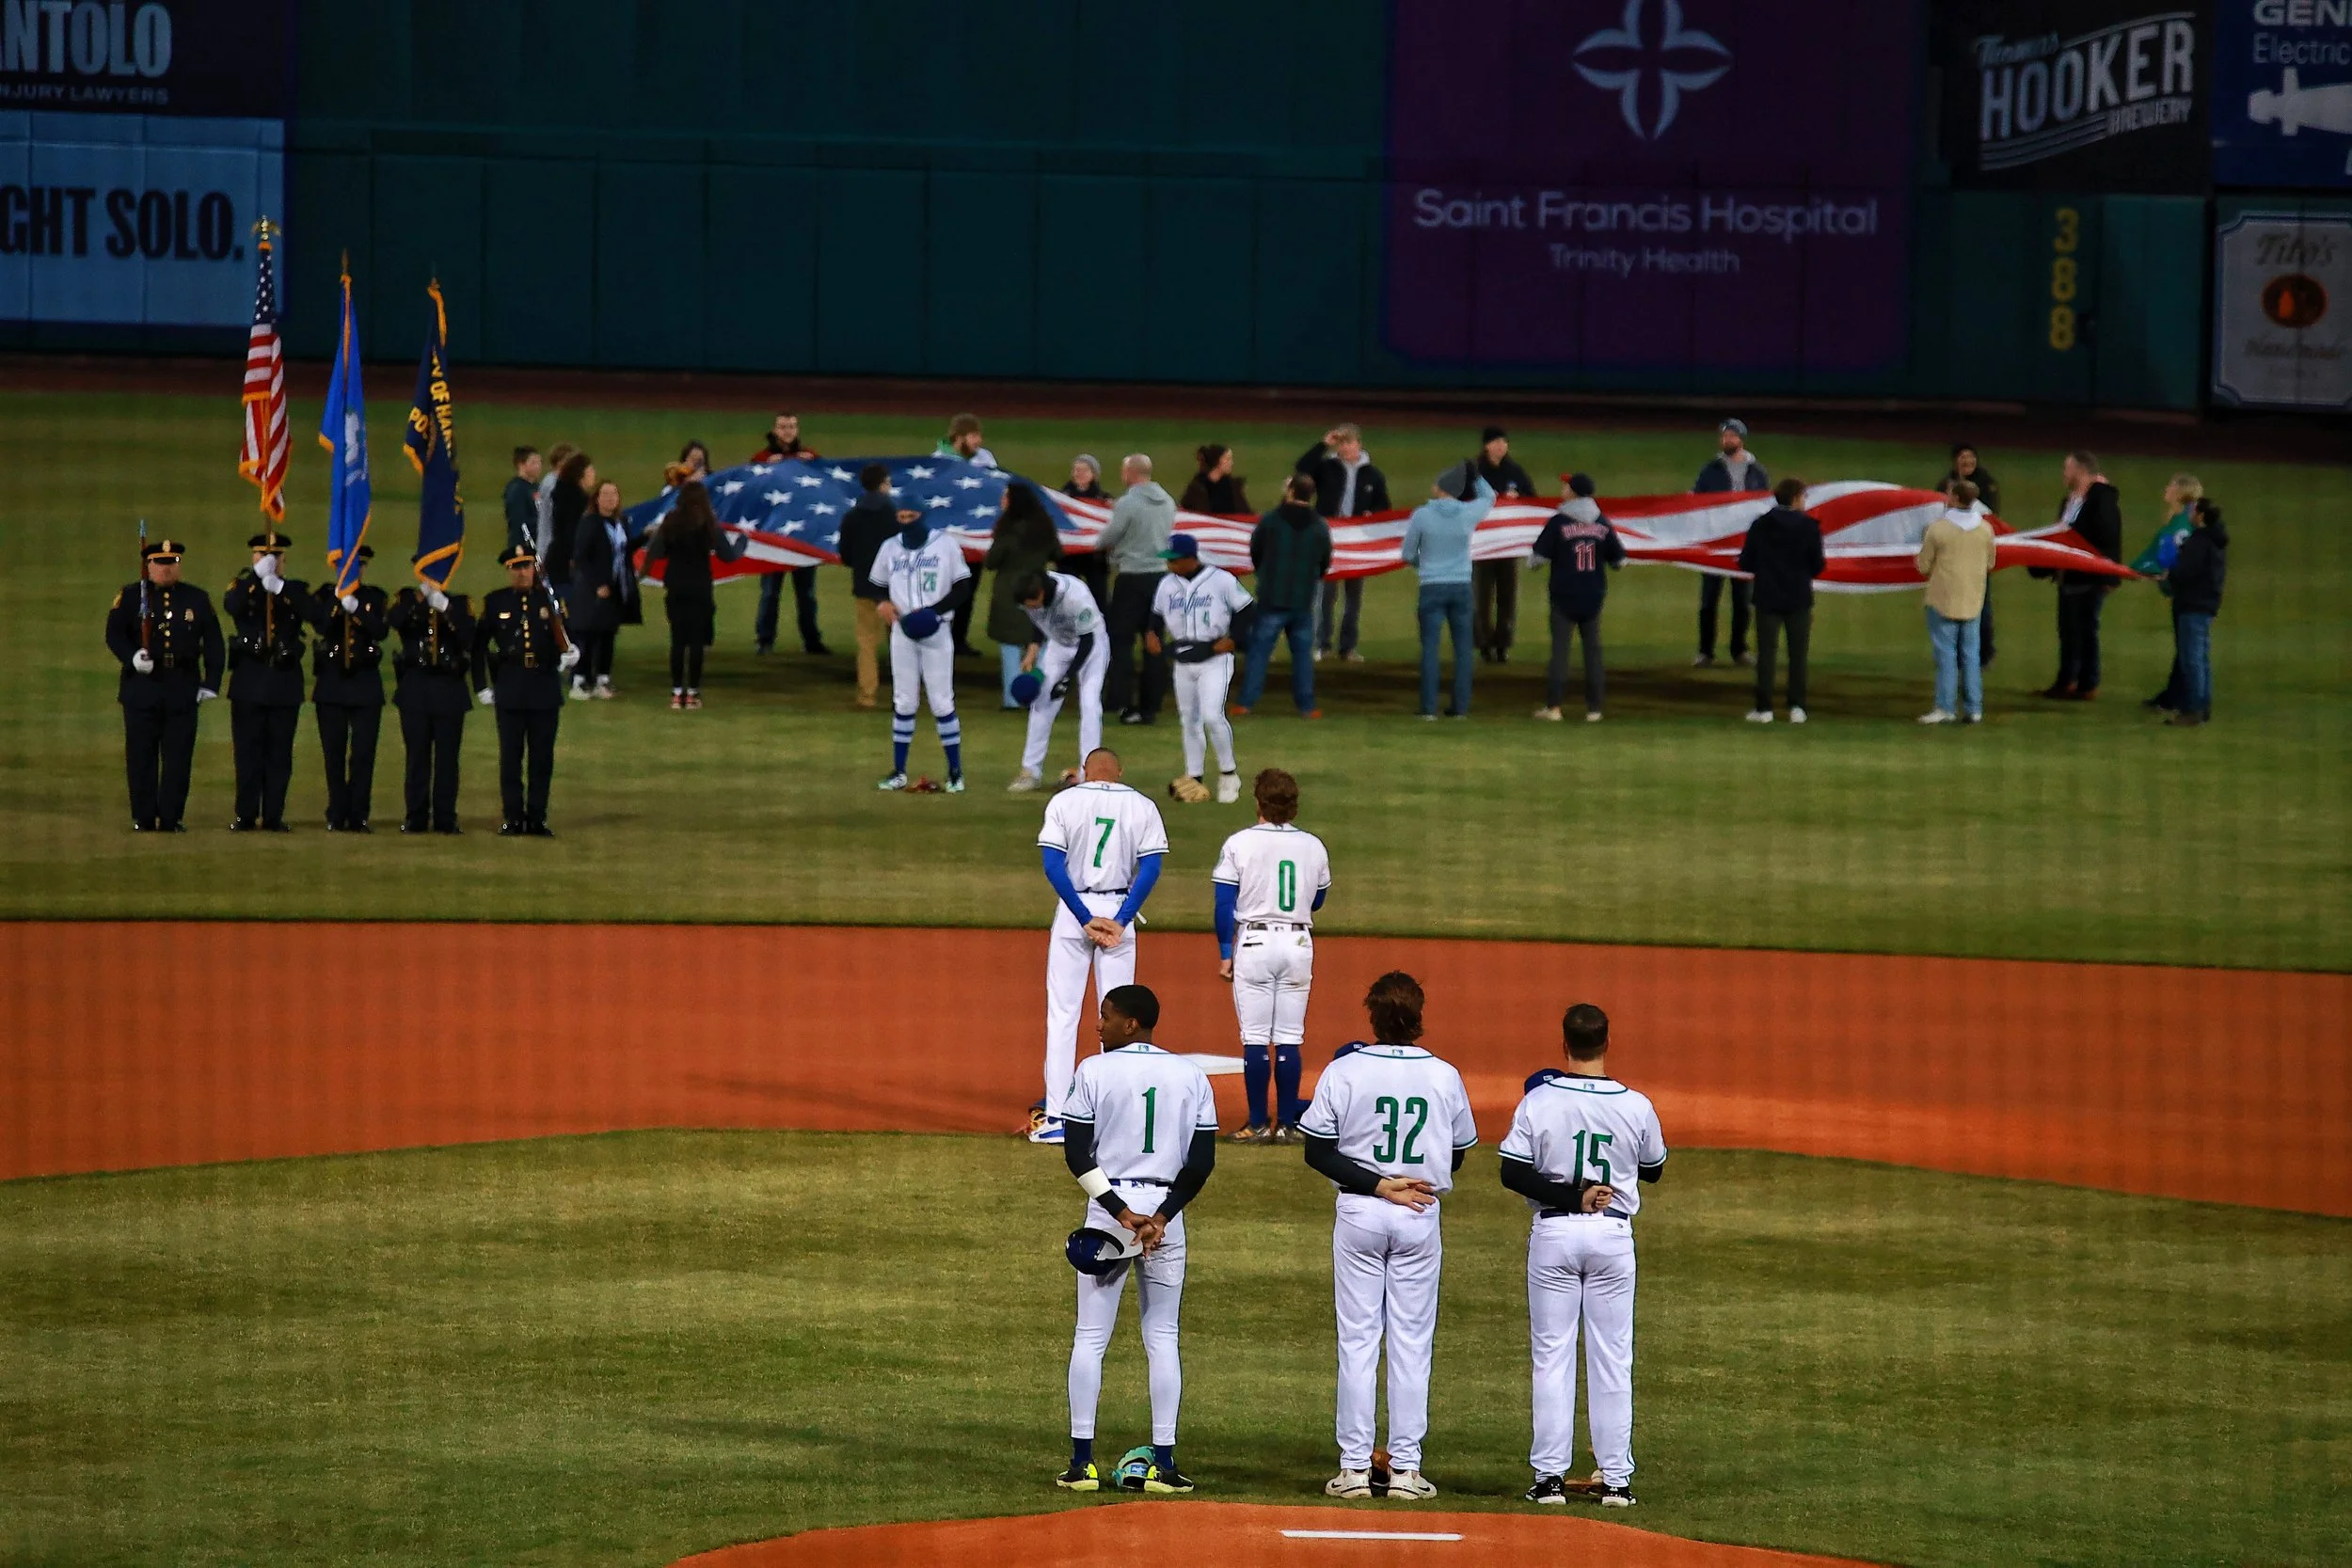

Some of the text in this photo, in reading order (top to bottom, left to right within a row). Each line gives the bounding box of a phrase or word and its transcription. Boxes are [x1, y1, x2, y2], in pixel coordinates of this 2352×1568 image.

[0, 0, 172, 78] NTOLO
[2252, 0, 2352, 26] GEN
[2252, 32, 2351, 65] Electric
[70, 86, 170, 105] LAWYERS
[1979, 20, 2195, 140] HOOKER
[0, 185, 245, 261] GHT SOLO.
[1413, 189, 1878, 245] Saint Francis Hospital
[1550, 244, 1740, 277] Trinity Health
[2049, 206, 2080, 352] 388
[923, 571, 938, 593] 26
[1574, 540, 1597, 573] 11
[1093, 816, 1116, 868] 7
[1279, 860, 1295, 912] 0
[1141, 1086, 1156, 1153] 1
[1373, 1096, 1429, 1164] 32
[1572, 1130, 1613, 1185] 15
